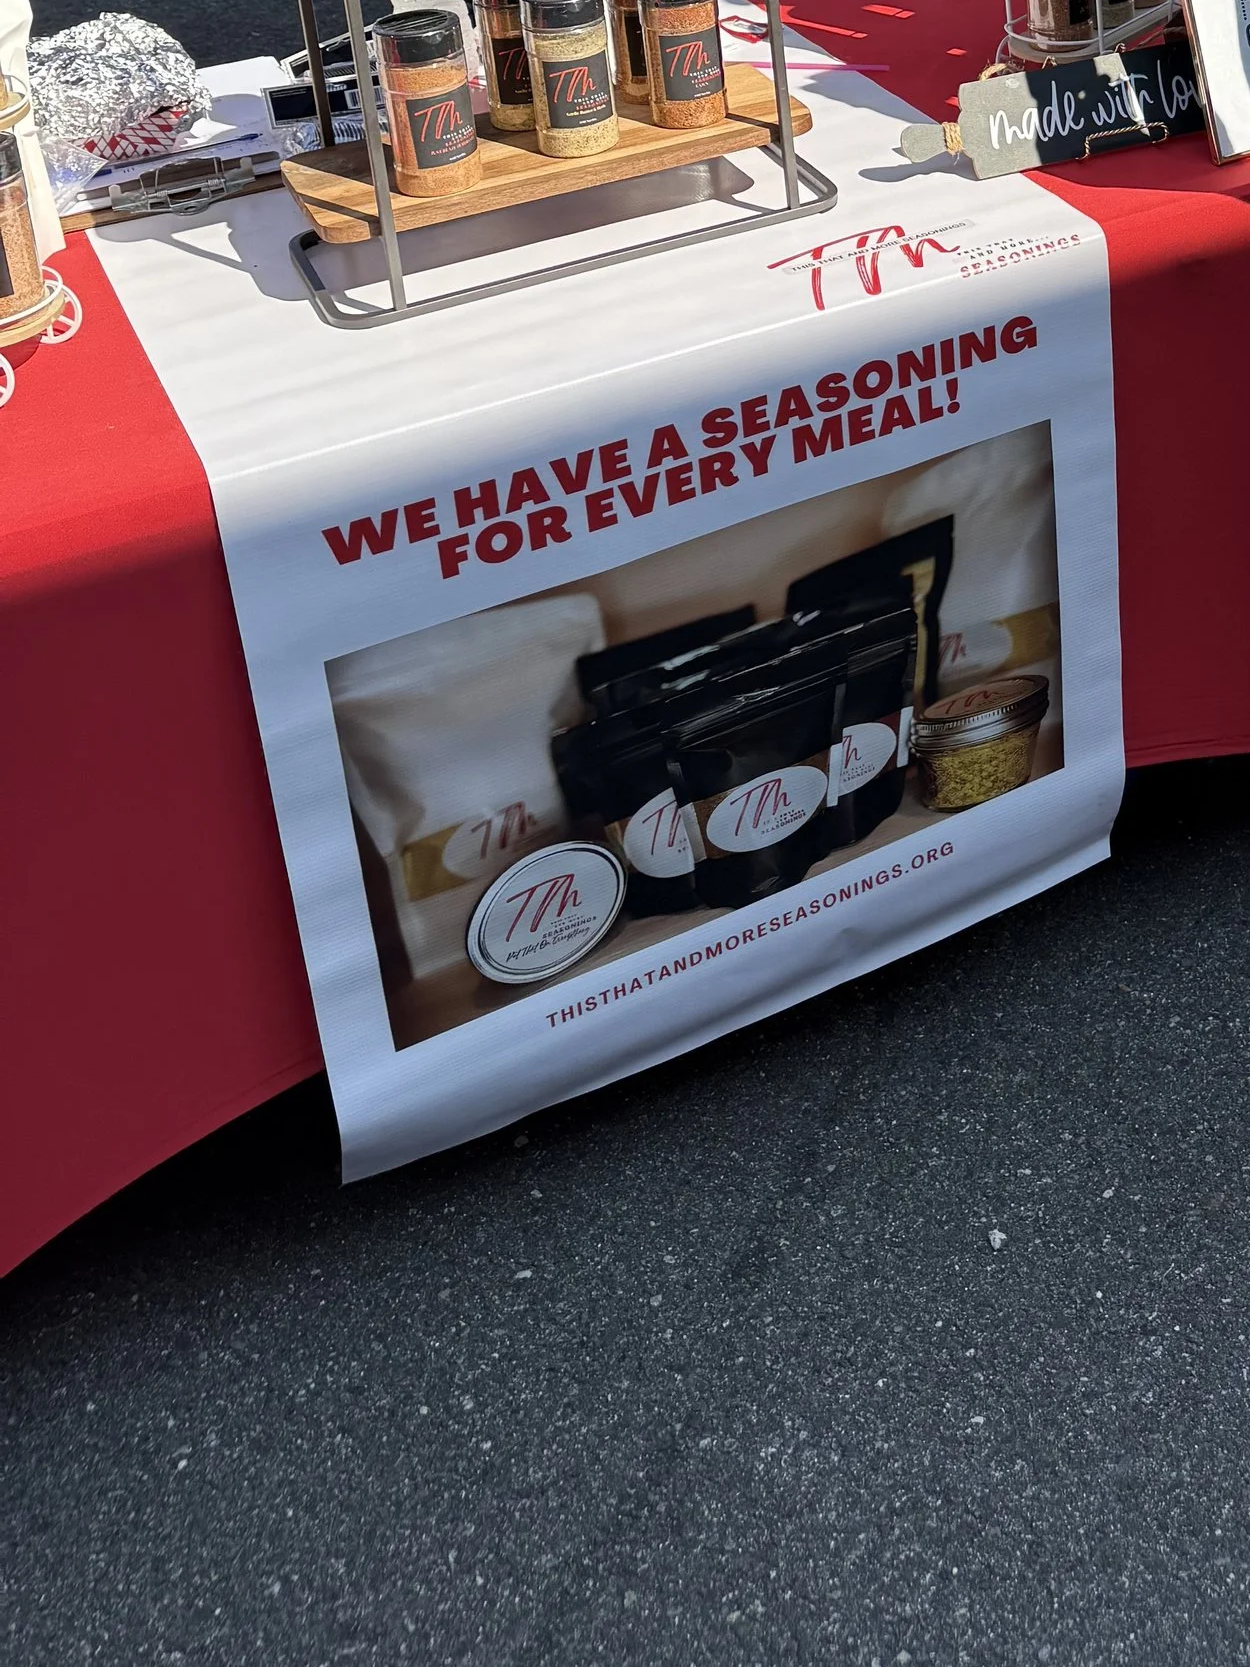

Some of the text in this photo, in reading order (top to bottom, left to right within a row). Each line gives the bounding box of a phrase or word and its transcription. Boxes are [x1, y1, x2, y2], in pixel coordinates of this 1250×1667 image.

[989, 81, 1084, 149] made
[1092, 73, 1154, 125] with
[791, 263, 815, 272] THIS
[818, 255, 844, 265] THAT
[847, 249, 869, 257] AND
[871, 240, 901, 251] MORE
[960, 234, 1081, 279] SEASONINGS
[970, 250, 993, 260] AND
[322, 314, 1039, 566] WE HAVE A SEASONING
[437, 377, 963, 580] FOR EVERY MEAL!
[545, 841, 955, 1028] THISTHATANDMORESEASONINGS.ORG
